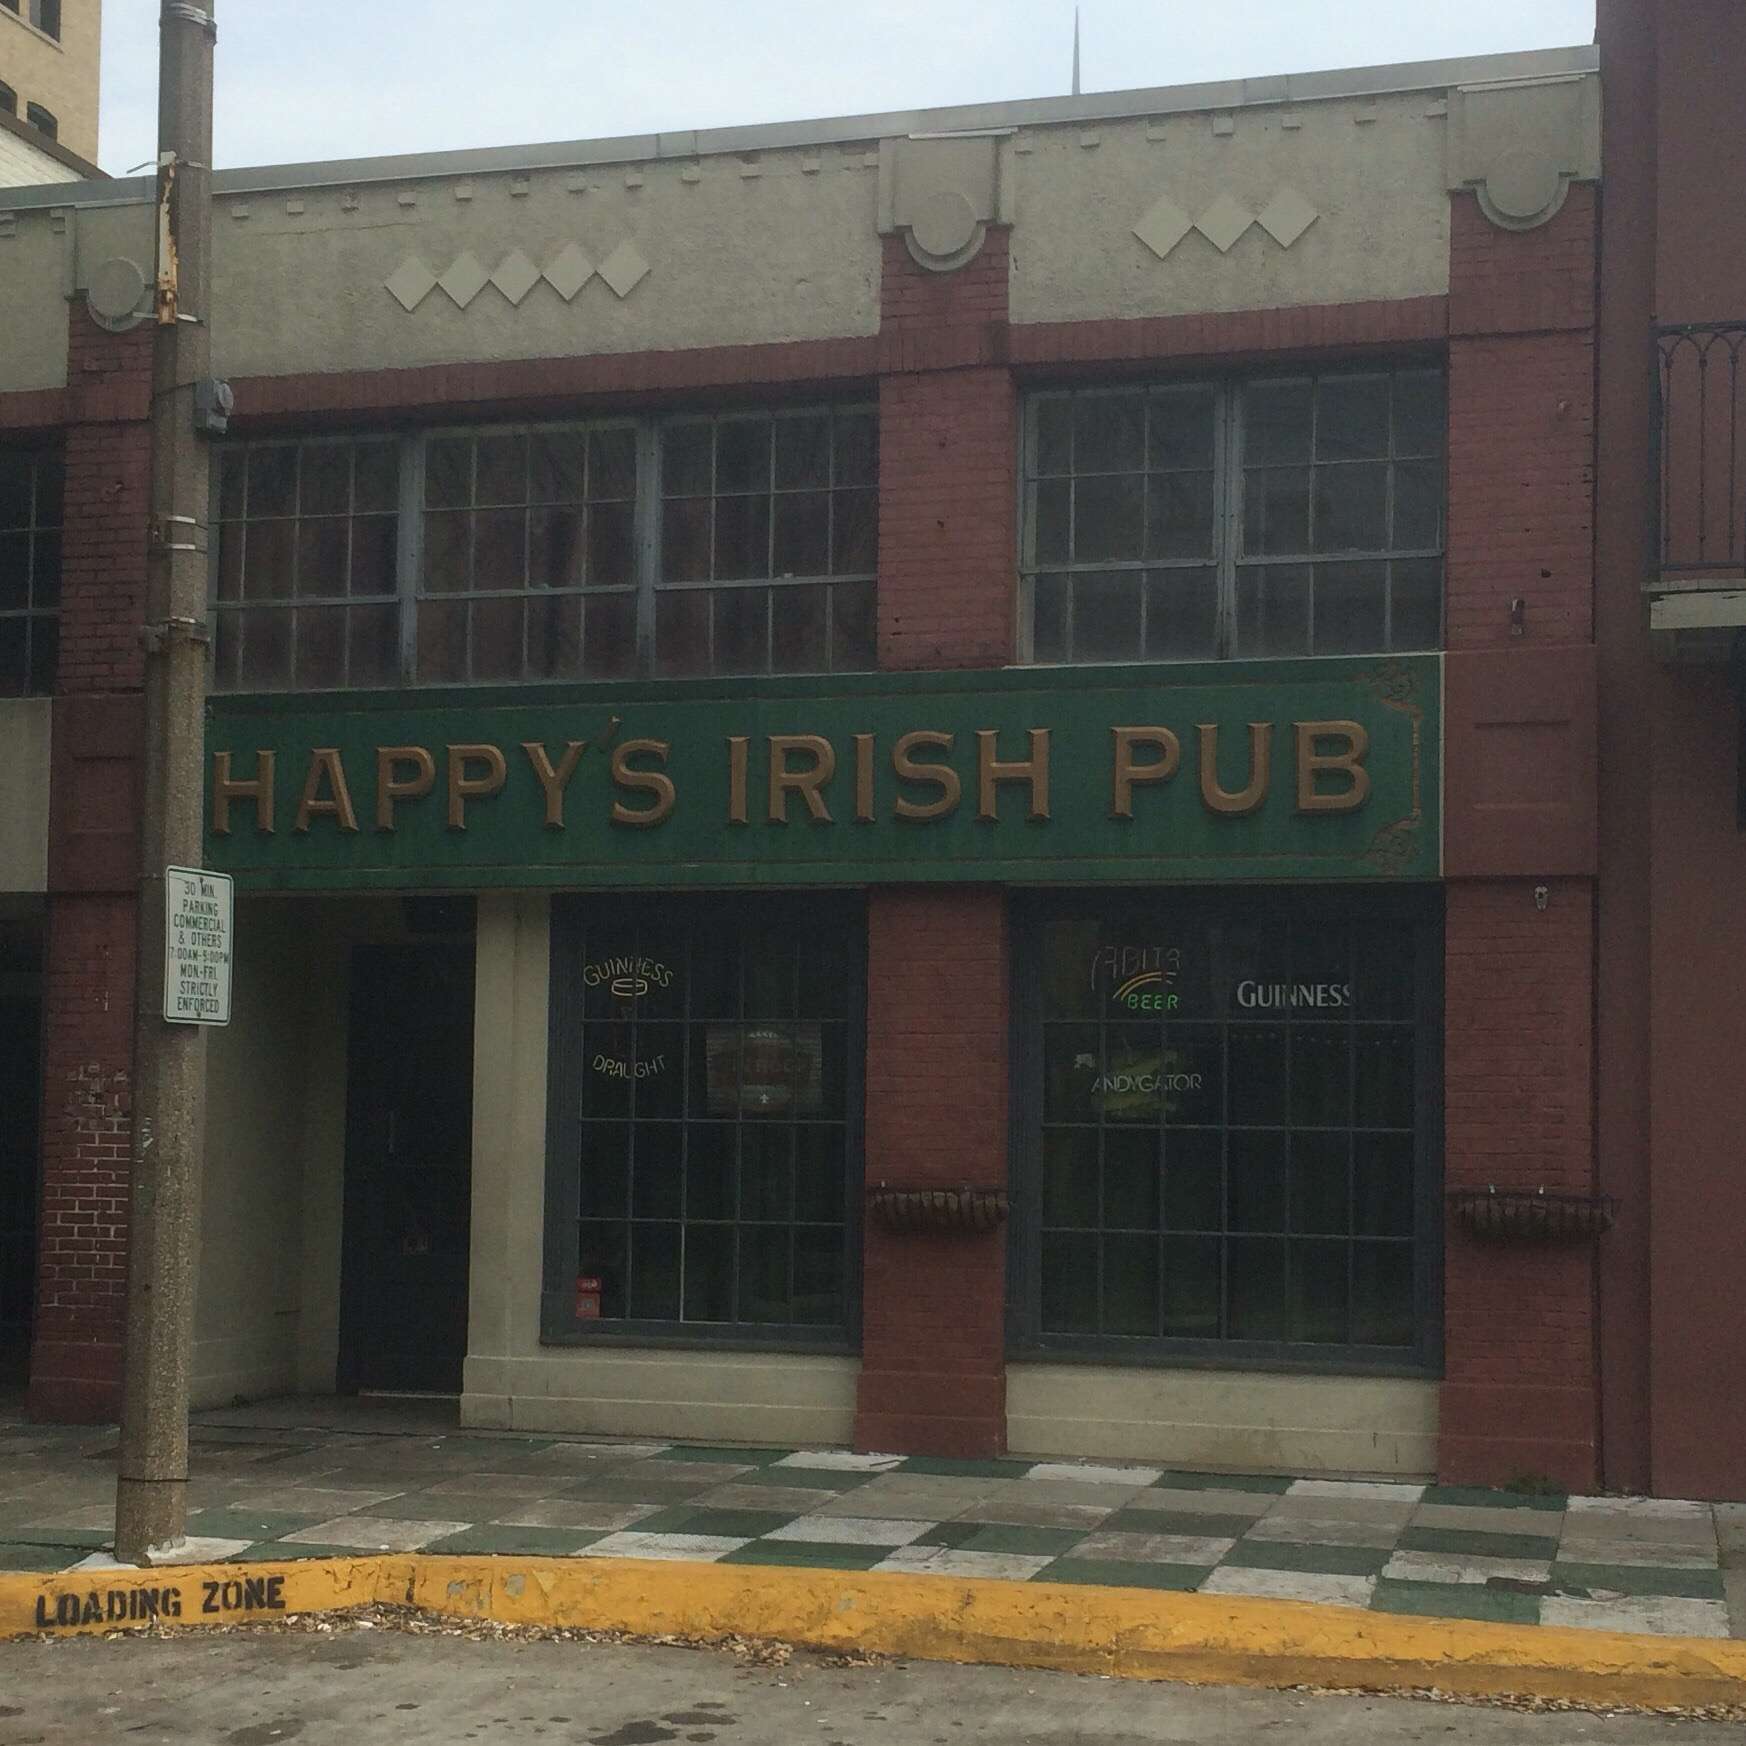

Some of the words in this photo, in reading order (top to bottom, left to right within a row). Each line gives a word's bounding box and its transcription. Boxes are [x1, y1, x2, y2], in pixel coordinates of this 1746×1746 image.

[213, 714, 677, 835] HAPPY'S
[726, 728, 1054, 825] IRISH
[1110, 718, 1372, 820] PUB
[184, 880, 196, 896] 30
[182, 898, 218, 917] PARKING
[173, 913, 226, 933] COMMERCIAL
[191, 931, 222, 949] OTHERS
[180, 980, 218, 998] STRICTLY
[177, 996, 220, 1014] ENFORCED
[1126, 993, 1180, 1010] BEER
[592, 1054, 666, 1080] DRAUGHT
[1090, 1073, 1203, 1094] ANDYGATOR
[36, 1587, 182, 1628] LOADING
[202, 1576, 286, 1614] ZONE
